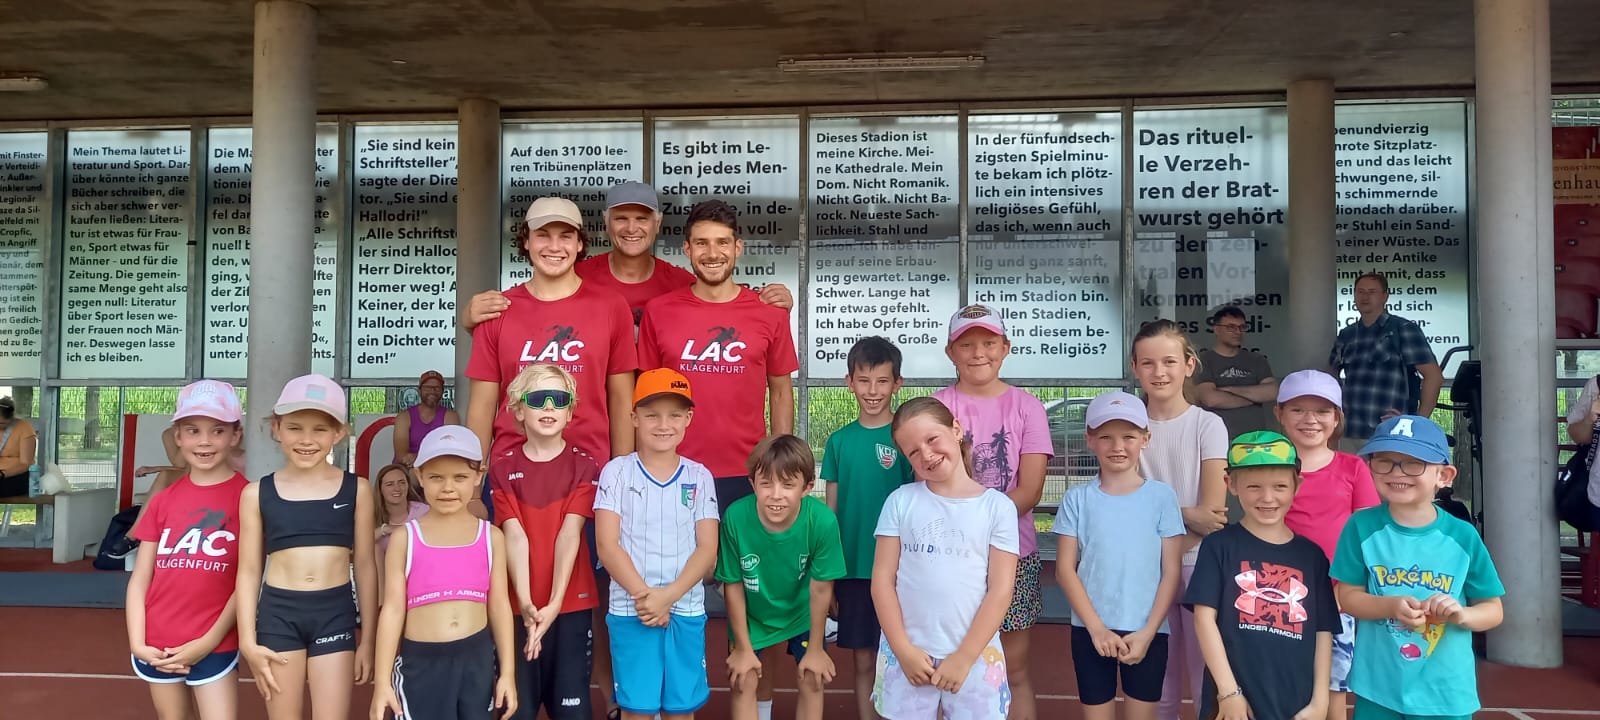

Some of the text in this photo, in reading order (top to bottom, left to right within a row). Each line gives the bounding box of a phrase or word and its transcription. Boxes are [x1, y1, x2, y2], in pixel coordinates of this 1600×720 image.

[816, 130, 927, 142] Dieses Stadion ist
[975, 131, 1115, 145] In der fünfundsech-
[1139, 126, 1252, 145] Das rituel-
[72, 144, 186, 156] Mein Thema lautet Li-
[392, 139, 421, 150] sind
[425, 138, 454, 150] kein
[510, 144, 627, 156] Auf den 31700 lee-
[662, 140, 770, 158] Es gibt im Le-
[1373, 139, 1436, 153] Sitzplatz-
[214, 148, 234, 158] Die
[975, 149, 1108, 166] zigsten Spielminu-
[72, 159, 190, 172] teratur und Sport. Dar-
[1139, 153, 1250, 172] le Verzeh-
[1356, 154, 1452, 166] und das leicht
[532, 159, 631, 175] Tribünenplätzen
[662, 160, 787, 178] ben jedes Men-
[835, 162, 907, 173] Kathedrale.
[911, 161, 942, 172] Mein
[359, 174, 426, 189] sagte der
[510, 175, 603, 186] könnten 31700
[1420, 170, 1440, 181] sil-
[662, 180, 750, 194] schen zwei
[816, 177, 949, 189] Dom. Nicht Romanik.
[1139, 180, 1278, 198] ren der Brat-
[975, 184, 1103, 197] lich ein intensives
[1344, 187, 1438, 198] schimmernde
[746, 200, 792, 214] in de-
[975, 202, 1100, 218] religiöses Gefühl,
[1398, 203, 1457, 214] darüber.
[816, 208, 939, 220] rock. Neueste Sach-
[1138, 206, 1284, 230] wurst gehört
[746, 220, 782, 234] voll-
[69, 241, 169, 254] en, Sport etwas für
[212, 240, 241, 250] nuell
[1344, 235, 1459, 247] einer Wüste. Das
[211, 256, 238, 268] den,
[1365, 251, 1436, 263] der Antike
[68, 269, 180, 282] Zeitung. Die gemein-
[358, 263, 457, 276] Herr Direktor,
[815, 271, 950, 285] ung gewartet. Lange.
[975, 272, 1109, 286] immer habe, wenn
[358, 281, 444, 295] Homer weg!
[815, 286, 930, 300] Schwer. Lange hat
[975, 289, 1108, 302] ich im Stadion bin.
[67, 324, 182, 334] der Frauen noch Män-
[358, 316, 447, 330] Hallodri war,
[815, 317, 942, 331] Ich habe Opfer brin-
[209, 332, 242, 343] stand
[1012, 325, 1109, 337] in diesem be-
[209, 350, 242, 358] unter
[520, 340, 584, 362] LAC
[680, 340, 747, 362] LAC
[1040, 342, 1106, 358] Religiös?
[66, 352, 81, 362] ich
[98, 352, 142, 362] bleiben.
[680, 364, 745, 373] KLAGENFURT
[1390, 418, 1414, 438] A
[157, 528, 236, 556] LAC
[315, 634, 345, 644] CRAFT
[1269, 627, 1302, 640] ARMOUR
